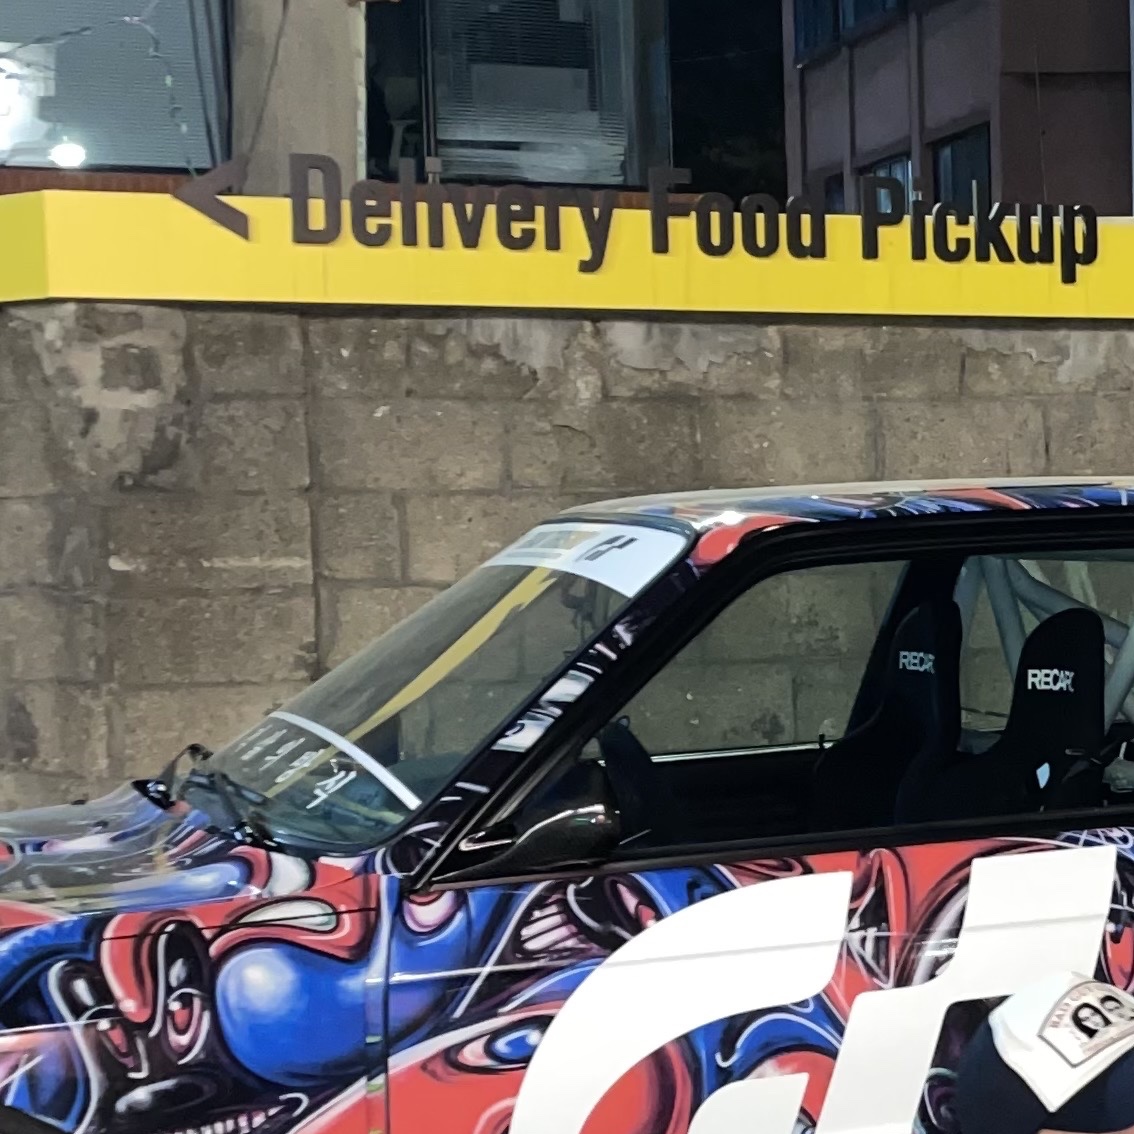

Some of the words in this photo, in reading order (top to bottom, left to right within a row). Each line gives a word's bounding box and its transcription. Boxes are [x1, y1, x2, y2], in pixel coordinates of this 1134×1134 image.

[290, 153, 614, 273] Delivery
[649, 167, 827, 259] Food
[860, 174, 1098, 285] Pickup
